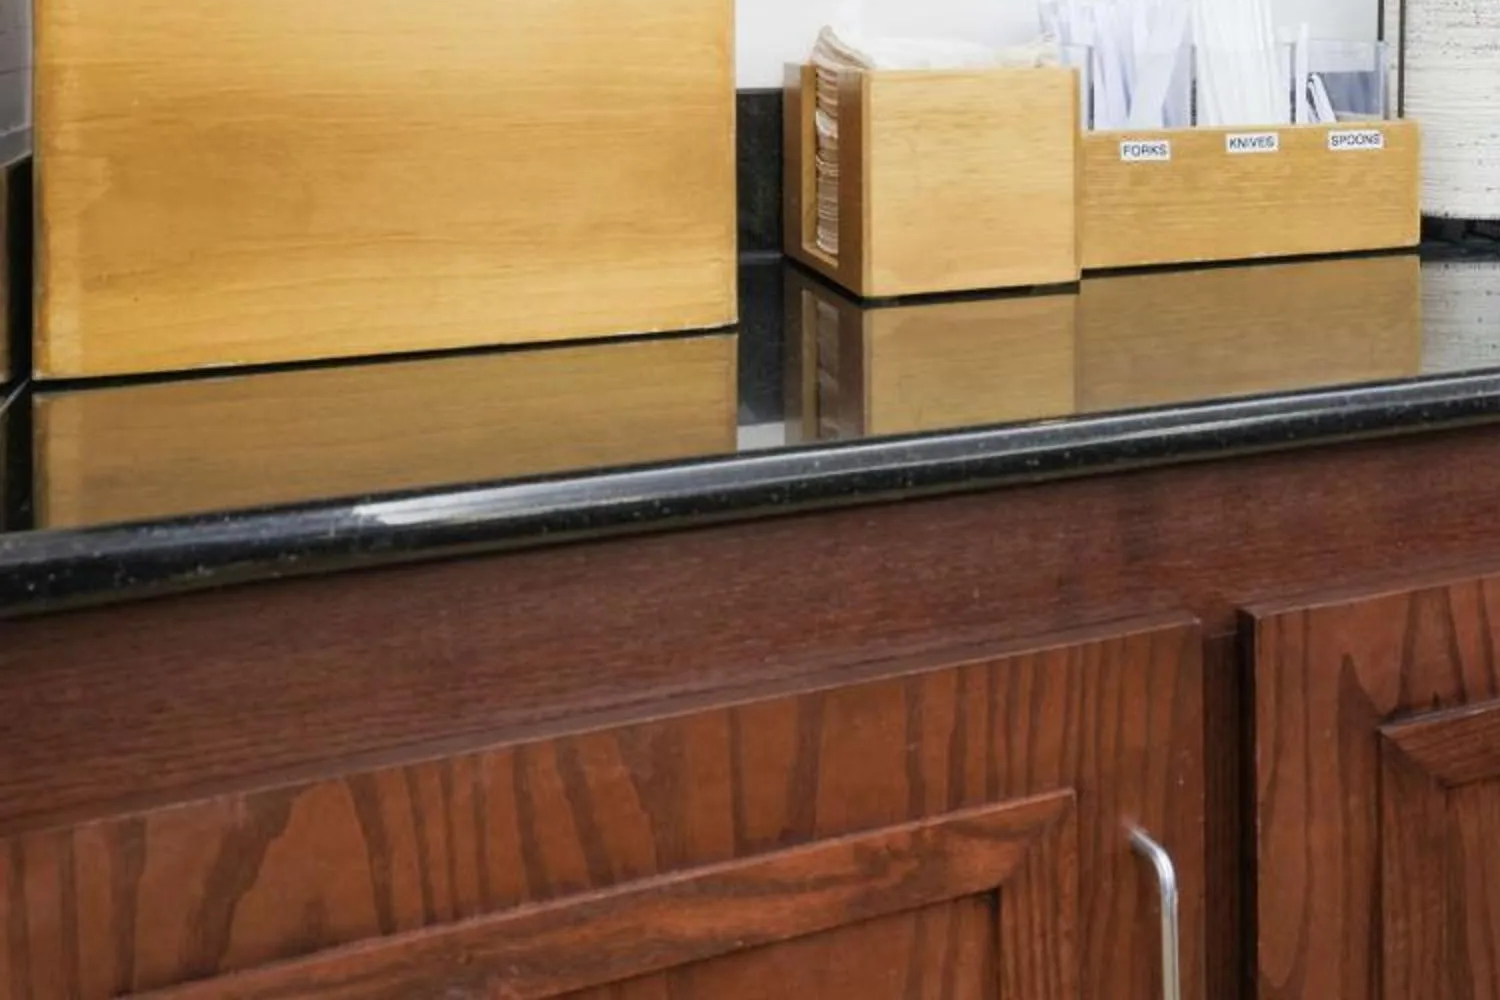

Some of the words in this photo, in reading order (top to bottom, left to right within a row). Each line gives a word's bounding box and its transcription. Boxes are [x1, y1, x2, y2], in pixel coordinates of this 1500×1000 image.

[1229, 136, 1274, 149] KNIVES
[1331, 133, 1380, 146] SPOONS
[1123, 143, 1167, 157] FORKS
